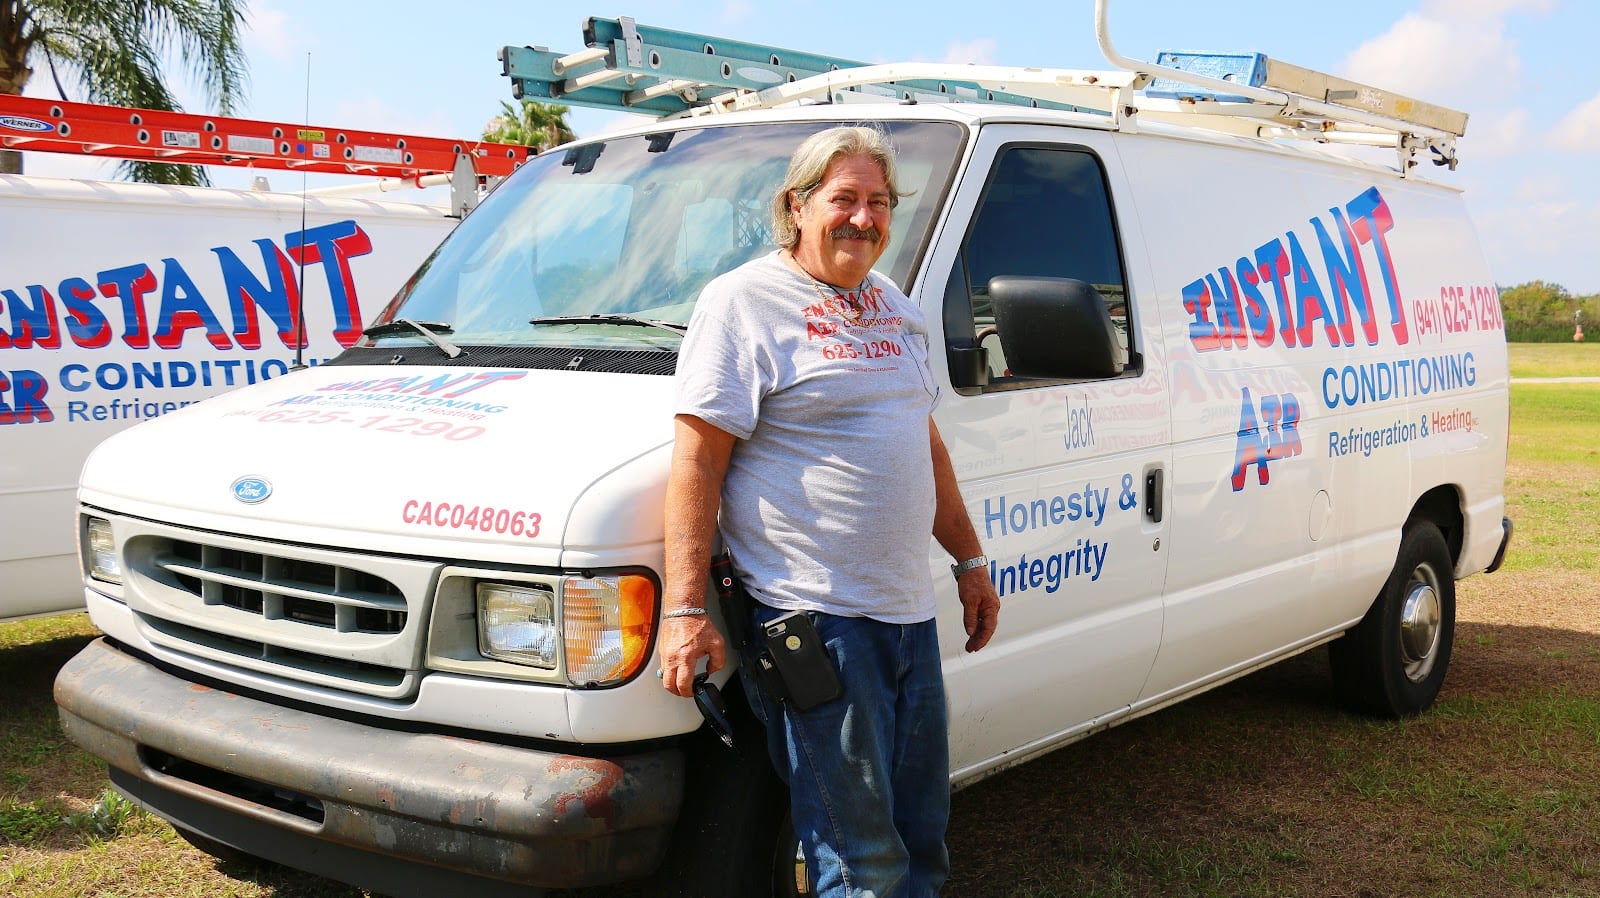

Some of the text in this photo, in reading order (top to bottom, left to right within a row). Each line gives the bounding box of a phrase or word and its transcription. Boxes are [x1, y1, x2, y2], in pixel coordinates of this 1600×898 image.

[2, 119, 42, 129] WERNER
[1182, 186, 1409, 353] INSTANT
[1412, 286, 1502, 345] (941) 625-1290
[59, 358, 333, 393] CONDITIO
[1322, 352, 1476, 409] CONDITIONING
[68, 397, 203, 422] Refriger
[256, 409, 487, 441] 625-1290
[328, 393, 508, 413] CONDITIONING
[423, 406, 488, 422] Heating
[1063, 393, 1095, 450] Jack
[1231, 386, 1303, 492] AIR
[1328, 419, 1417, 458] Refrigeration
[1420, 414, 1430, 438] &
[1431, 408, 1472, 434] Heating
[238, 481, 264, 497] Ford
[984, 473, 1137, 539] Honesty &
[402, 500, 542, 538] CAC048063
[990, 538, 1108, 597] Integrity
